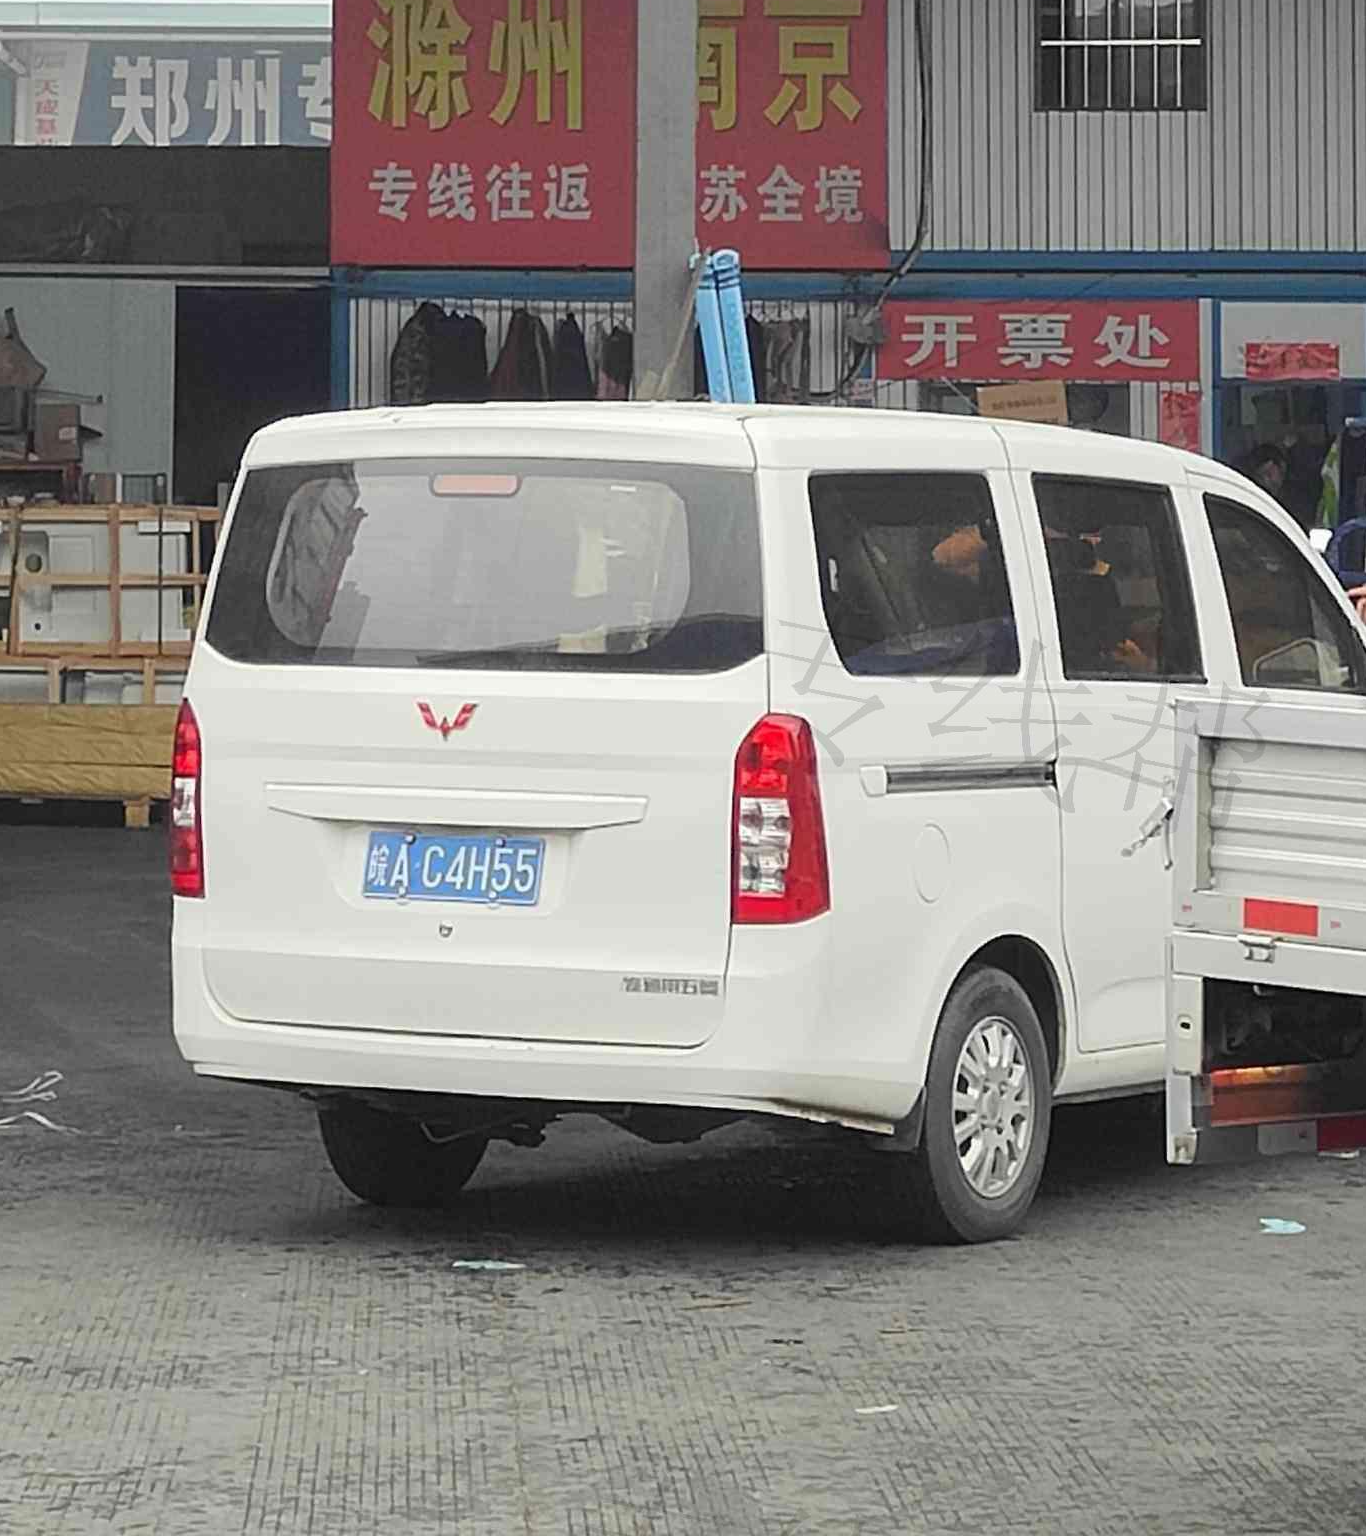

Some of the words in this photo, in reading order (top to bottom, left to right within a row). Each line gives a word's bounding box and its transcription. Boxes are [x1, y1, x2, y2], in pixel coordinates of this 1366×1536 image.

[367, 161, 594, 224] 专线往返
[900, 311, 1172, 370] 开票处
